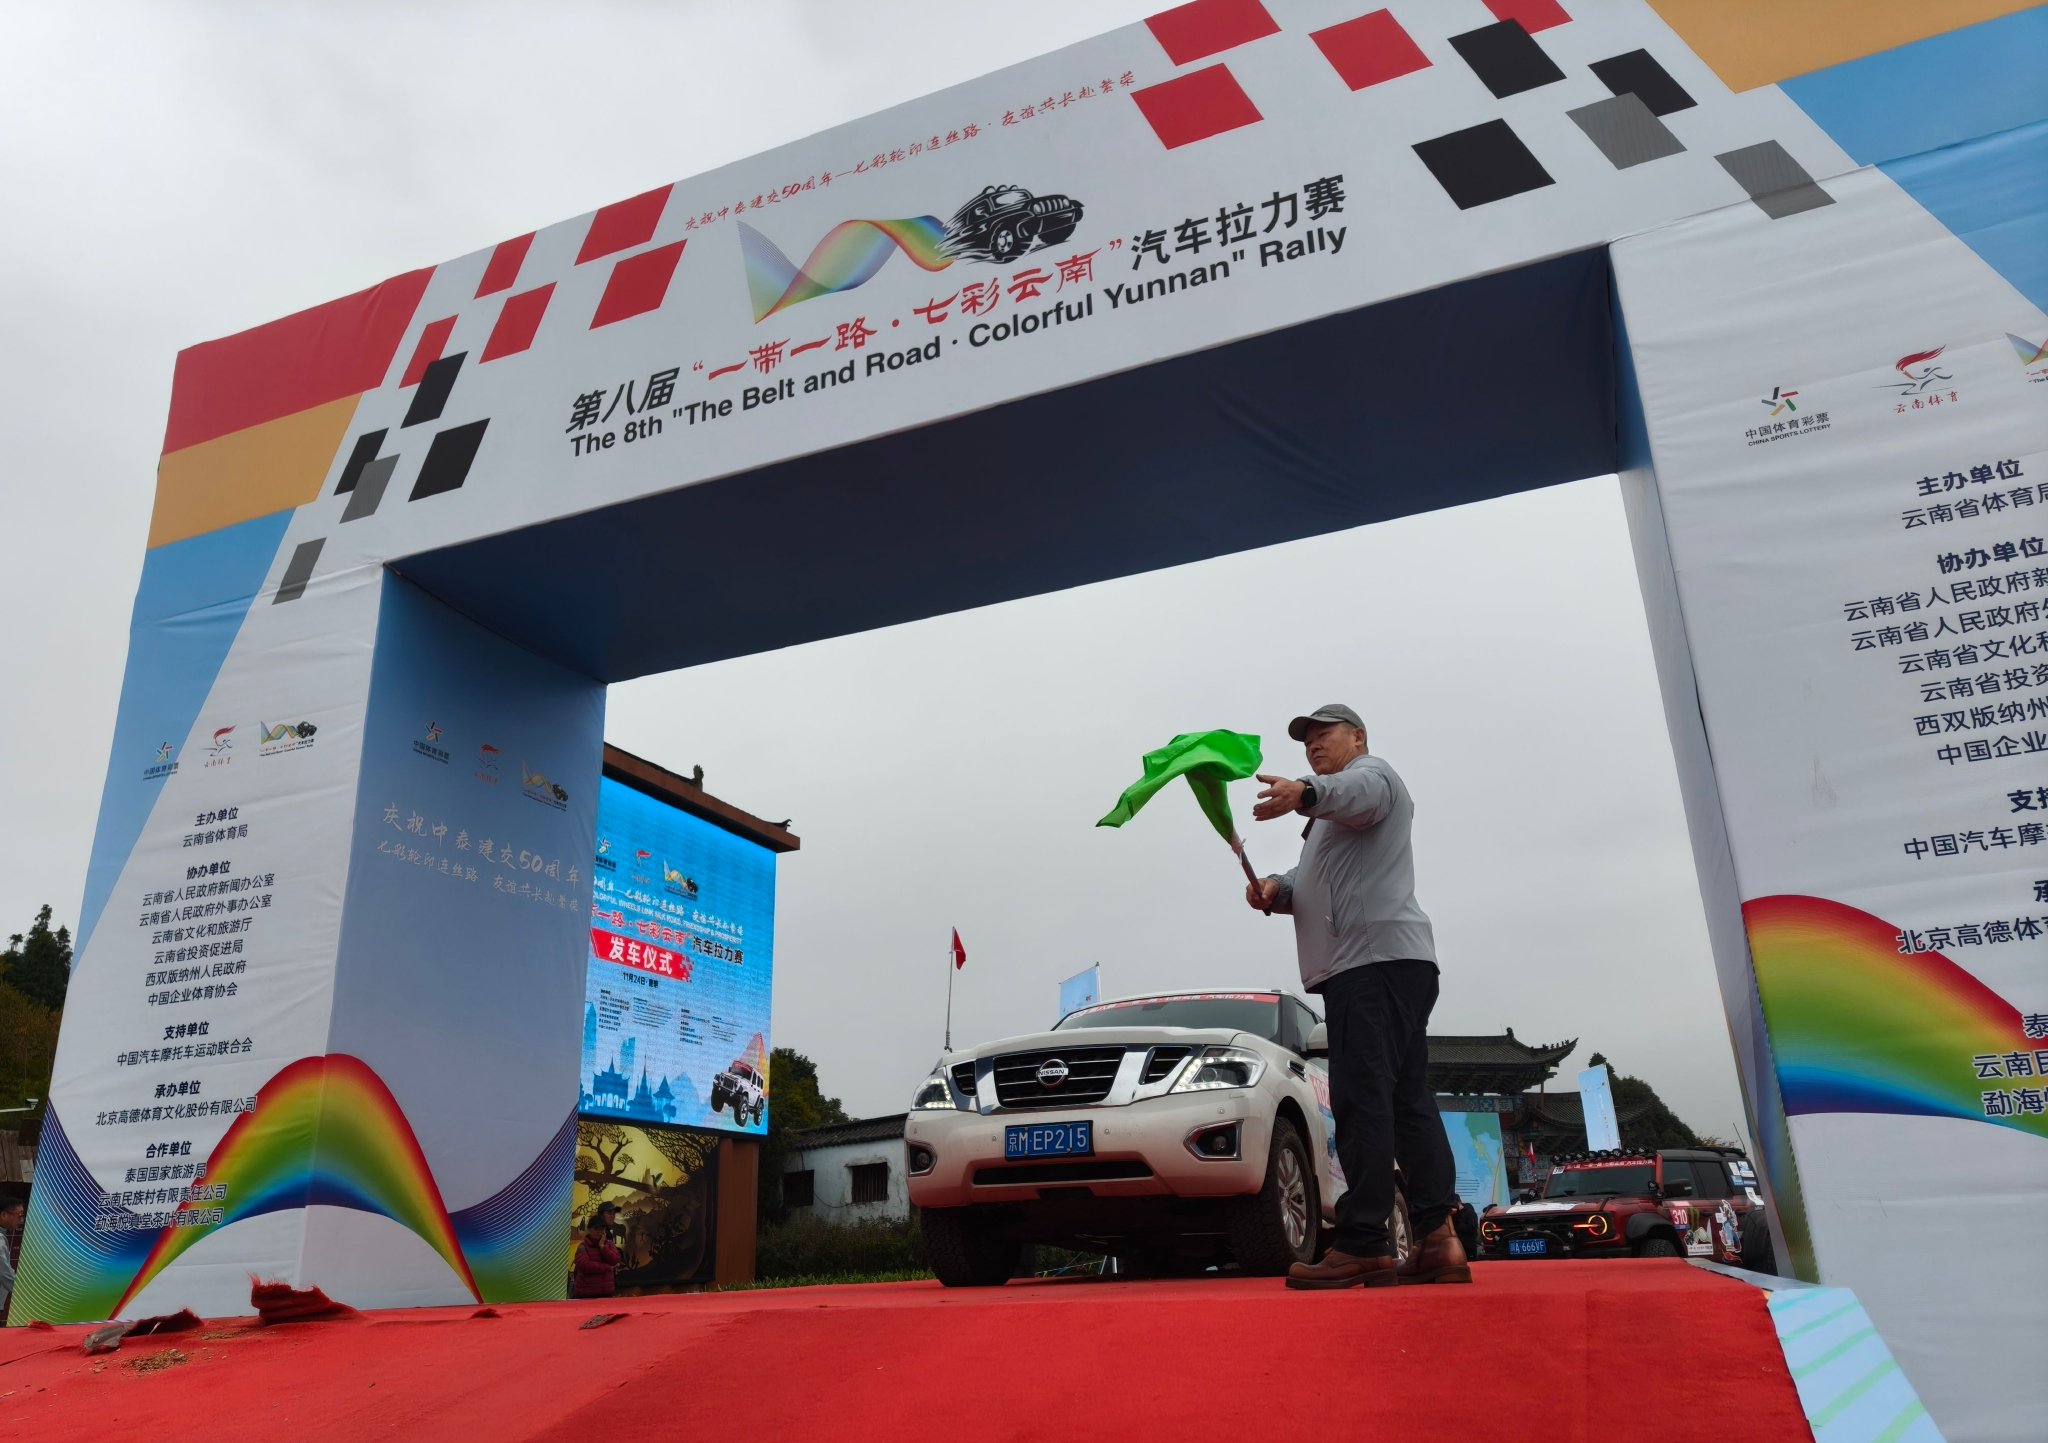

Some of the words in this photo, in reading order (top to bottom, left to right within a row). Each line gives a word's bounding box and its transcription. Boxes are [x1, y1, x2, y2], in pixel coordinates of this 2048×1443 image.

[570, 431, 616, 457] The
[623, 415, 663, 443] 8th
[672, 399, 733, 425] "The
[742, 378, 795, 411] Belt
[803, 360, 855, 394] and
[866, 336, 941, 376] Road
[968, 294, 1093, 348] Colorful
[1104, 249, 1245, 309] Yunnan"
[1259, 226, 1347, 268] Rally
[1893, 391, 1958, 414] 云南体育
[1745, 411, 1830, 440] 中国体育彩票
[1748, 437, 1770, 447] CHINA
[1770, 430, 1799, 443] SPORTS
[1799, 423, 1831, 435] LOTTERY
[1916, 458, 2024, 497] 主办单位
[1937, 536, 2048, 574] 协办单位
[1851, 598, 2048, 651] 云南省人民政府
[1913, 696, 2048, 736] 西双版纳州
[1937, 731, 2048, 765] 中国企业
[194, 807, 239, 826] 主办单位
[183, 824, 248, 847] 云南省体育局
[383, 802, 580, 888] 庆祝中泰建交50周年
[1904, 822, 2048, 860] 中国汽车摩
[186, 861, 231, 880] 协办单位
[142, 873, 275, 907] 云南省人民政府新闻办公室
[139, 894, 272, 927] 云南省人民政府外事办公室
[152, 917, 252, 944] 云南省文化和旅游厅
[1897, 916, 2048, 953] 北京高德体
[154, 939, 243, 964] 云南省投资促进局
[608, 936, 673, 975] 发车仪式
[145, 960, 246, 986] 西双版纳州人民政府
[148, 982, 238, 1006] 中国企业体育协会
[163, 1021, 209, 1040] 支持单位
[117, 1037, 253, 1067] 中国汽车摩托车运动联合会
[1037, 1068, 1065, 1077] NISSAN
[154, 1080, 201, 1098] 承办单位
[1983, 1087, 2048, 1115] 勐海
[96, 1096, 257, 1126] 北京高德体育文化股份有限公司
[146, 1141, 192, 1158] 合作单位
[124, 1163, 207, 1183] 泰国国家旅游局
[98, 1184, 228, 1208] 云南民族村有限责任公司
[1672, 1208, 1688, 1225] 310
